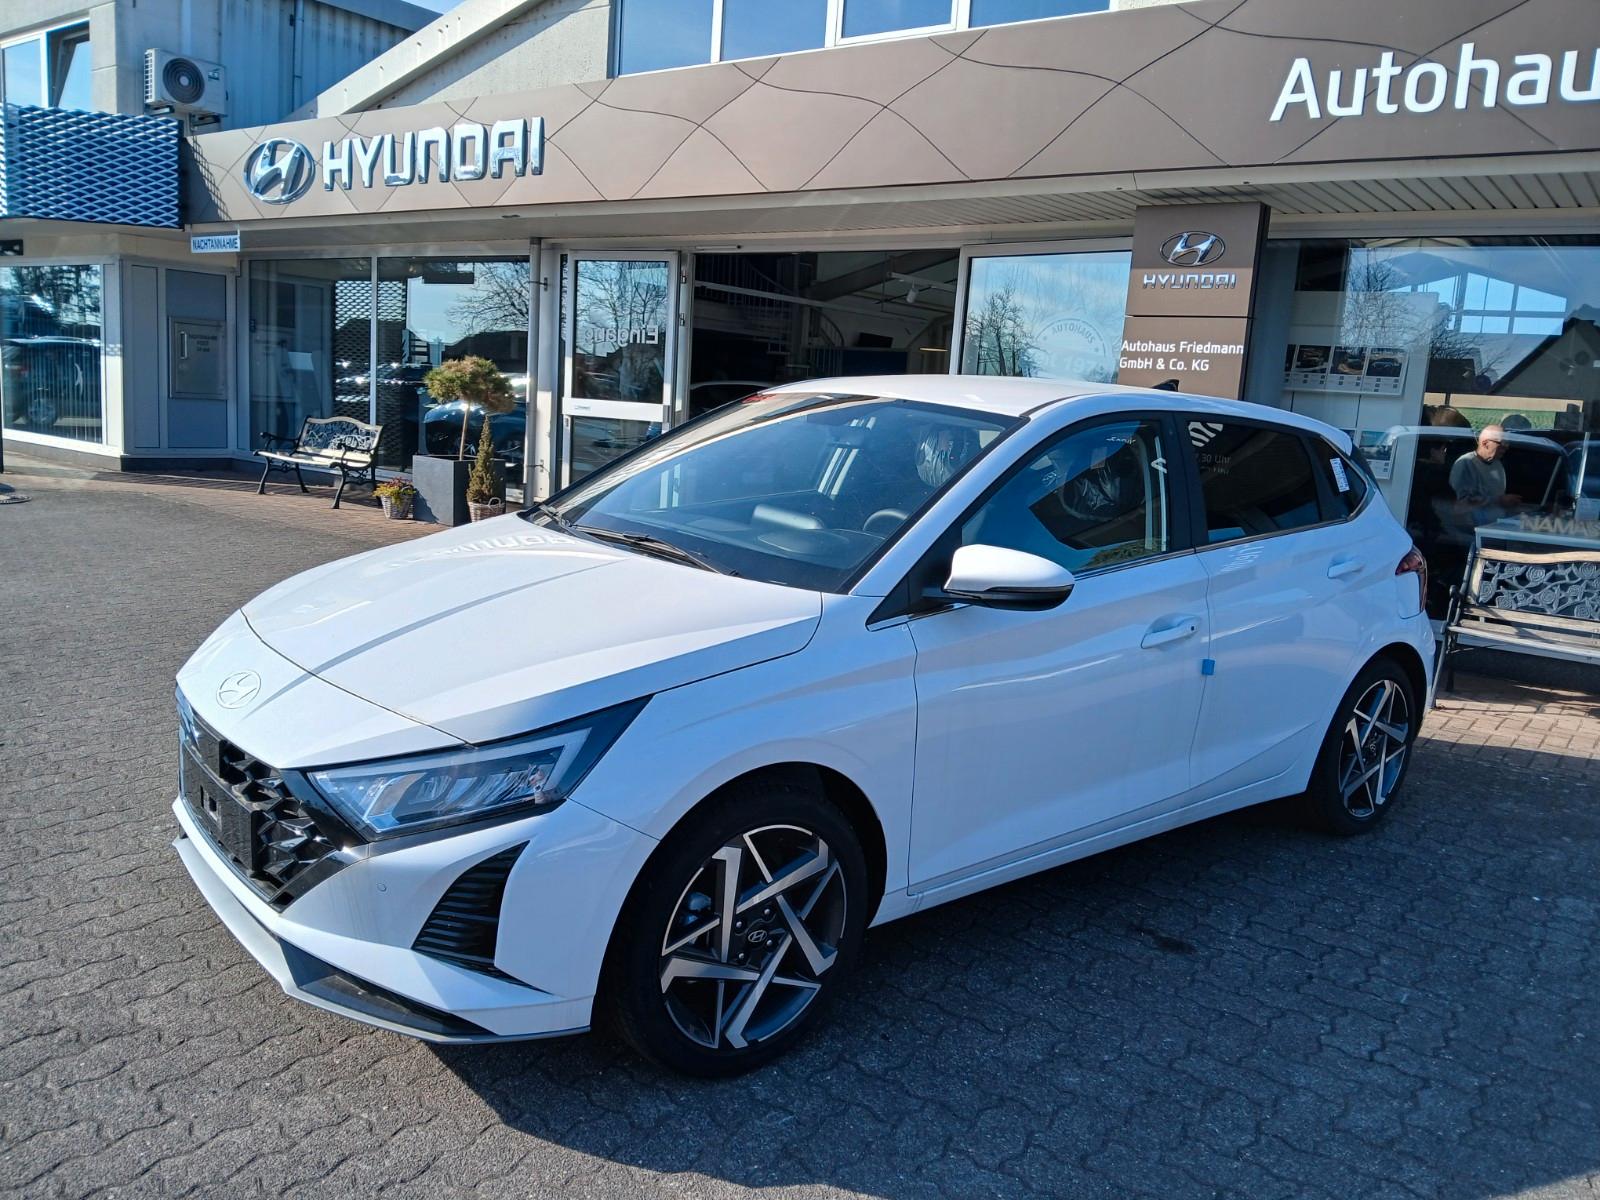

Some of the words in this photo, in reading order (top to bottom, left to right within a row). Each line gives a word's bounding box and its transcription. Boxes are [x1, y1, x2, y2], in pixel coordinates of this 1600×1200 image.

[1269, 42, 1600, 122] Autohau
[322, 116, 546, 192] HYUNDAI
[192, 237, 239, 250] NACHTANNAHME
[1142, 273, 1237, 289] HYUNDAI
[1121, 340, 1176, 353] Autohaus
[1179, 341, 1244, 355] Friedmann
[1119, 357, 1153, 370] GmbH
[1156, 358, 1166, 370] &
[1169, 358, 1188, 371] Co.
[1191, 359, 1210, 372] KG
